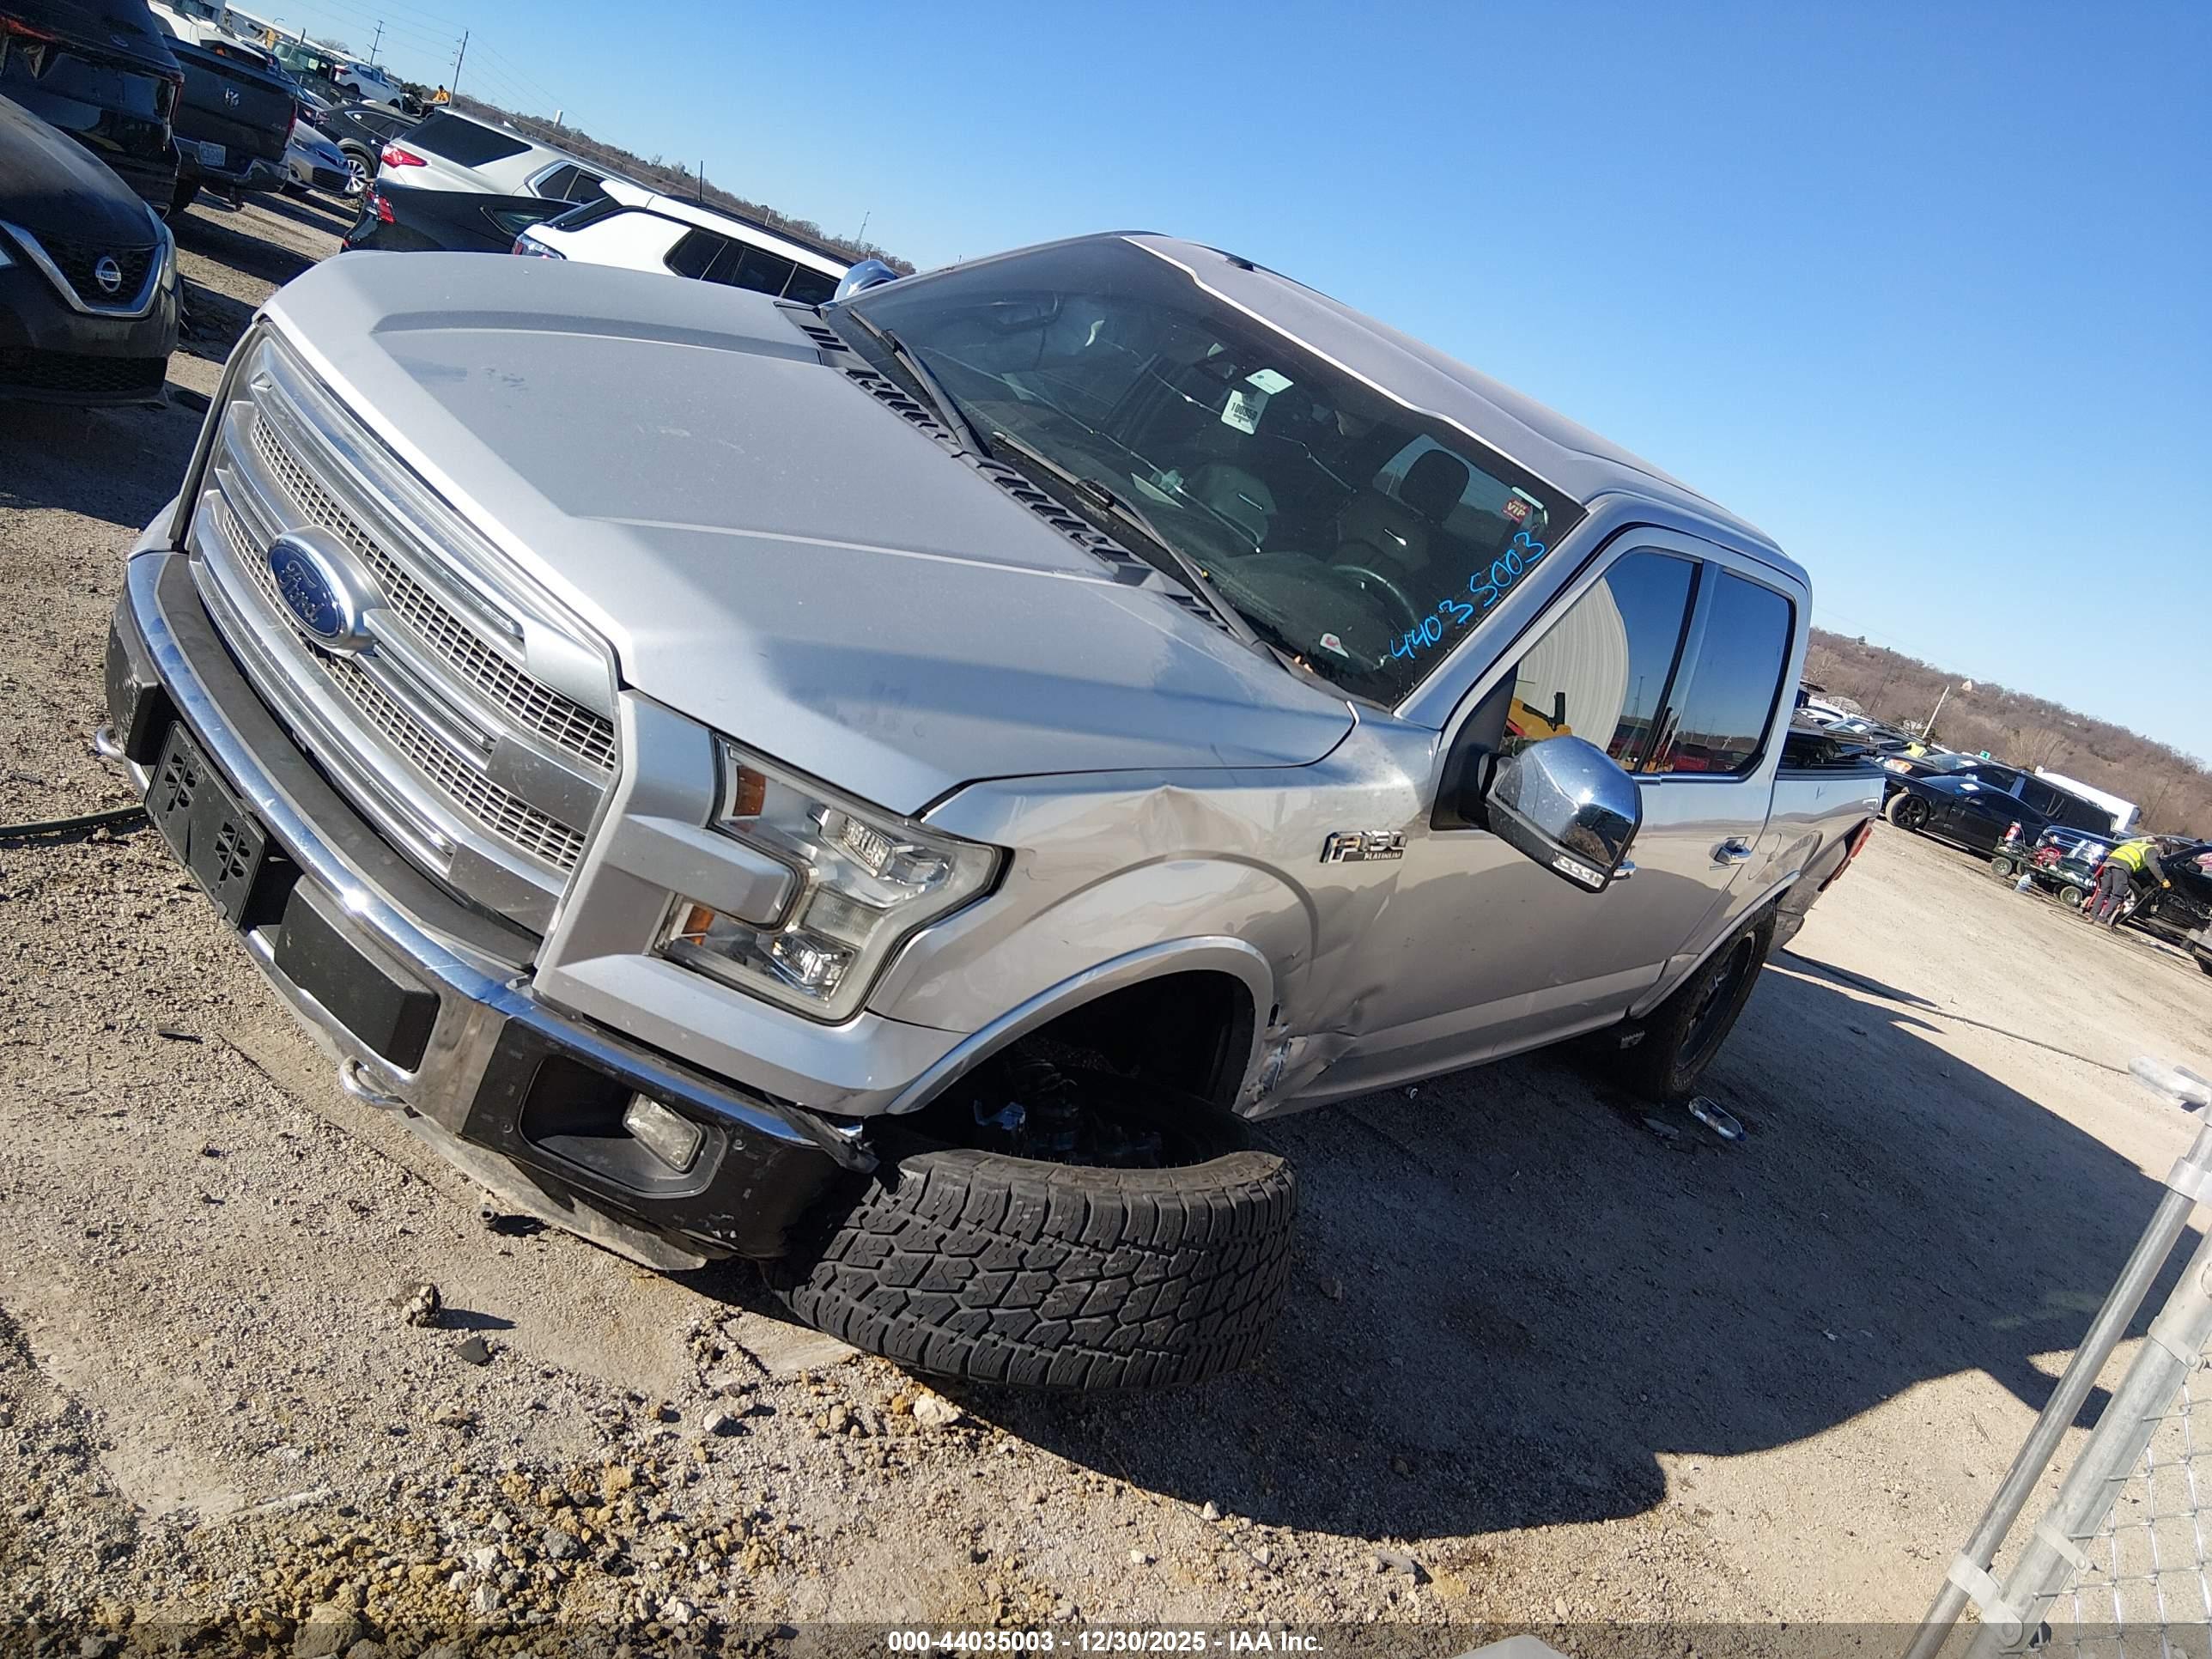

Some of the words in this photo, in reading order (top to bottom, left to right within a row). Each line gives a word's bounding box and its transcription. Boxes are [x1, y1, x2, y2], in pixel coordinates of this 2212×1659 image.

[1507, 501, 1526, 517] VIP
[278, 560, 323, 623] Ford
[1364, 851, 1402, 860] PLATINUM
